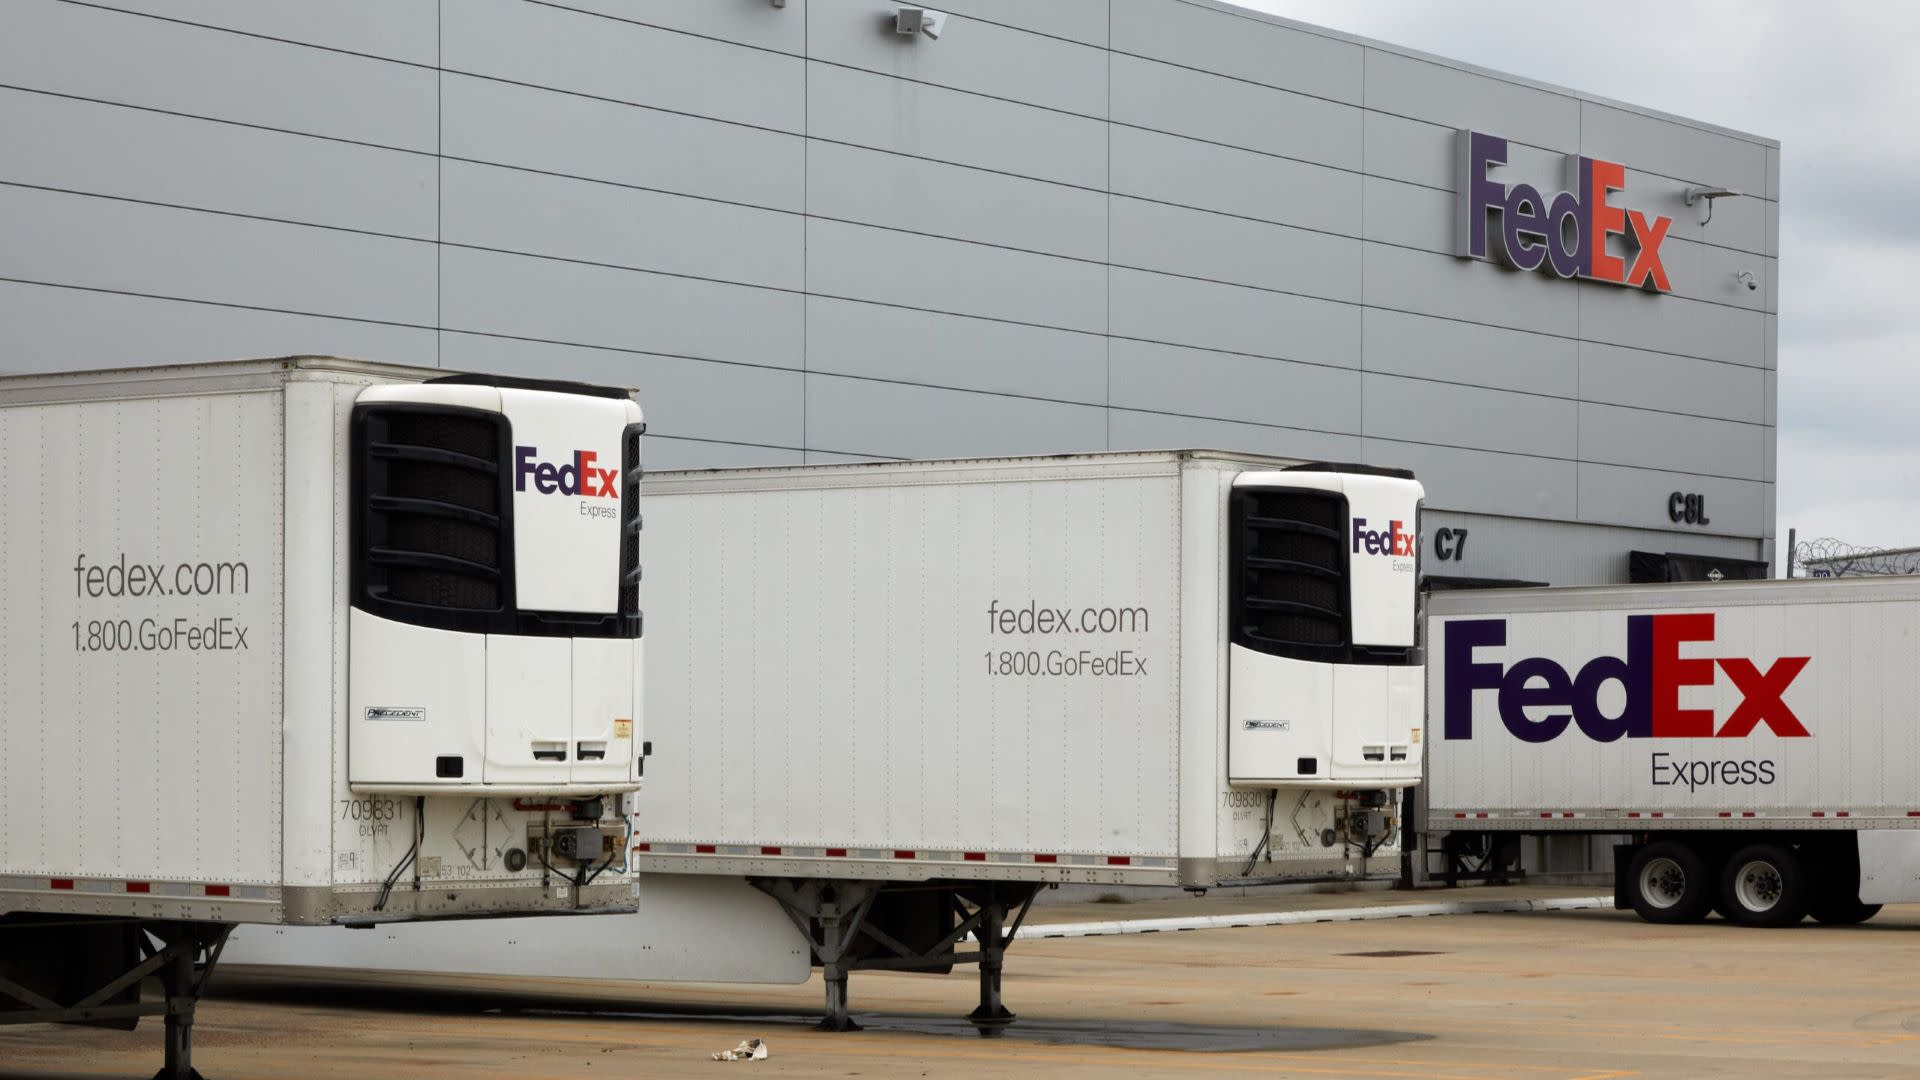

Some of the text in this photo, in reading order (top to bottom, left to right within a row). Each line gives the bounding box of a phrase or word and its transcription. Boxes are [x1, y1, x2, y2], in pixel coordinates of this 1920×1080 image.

[1467, 129, 1673, 292] FedEx
[515, 445, 619, 499] FedEx
[580, 500, 617, 519] Express
[1668, 491, 1710, 526] C8L
[1352, 517, 1415, 557] FedEx
[1434, 527, 1468, 561] C7
[73, 553, 249, 598] fedex.com
[71, 617, 249, 651] 1.800.GoFedEx
[987, 599, 1149, 634] fedex.com
[984, 650, 1148, 676] 1.800.GoFedEx
[1444, 613, 1812, 743] FedEx
[1651, 752, 1776, 793] Express
[340, 799, 402, 820] 709831
